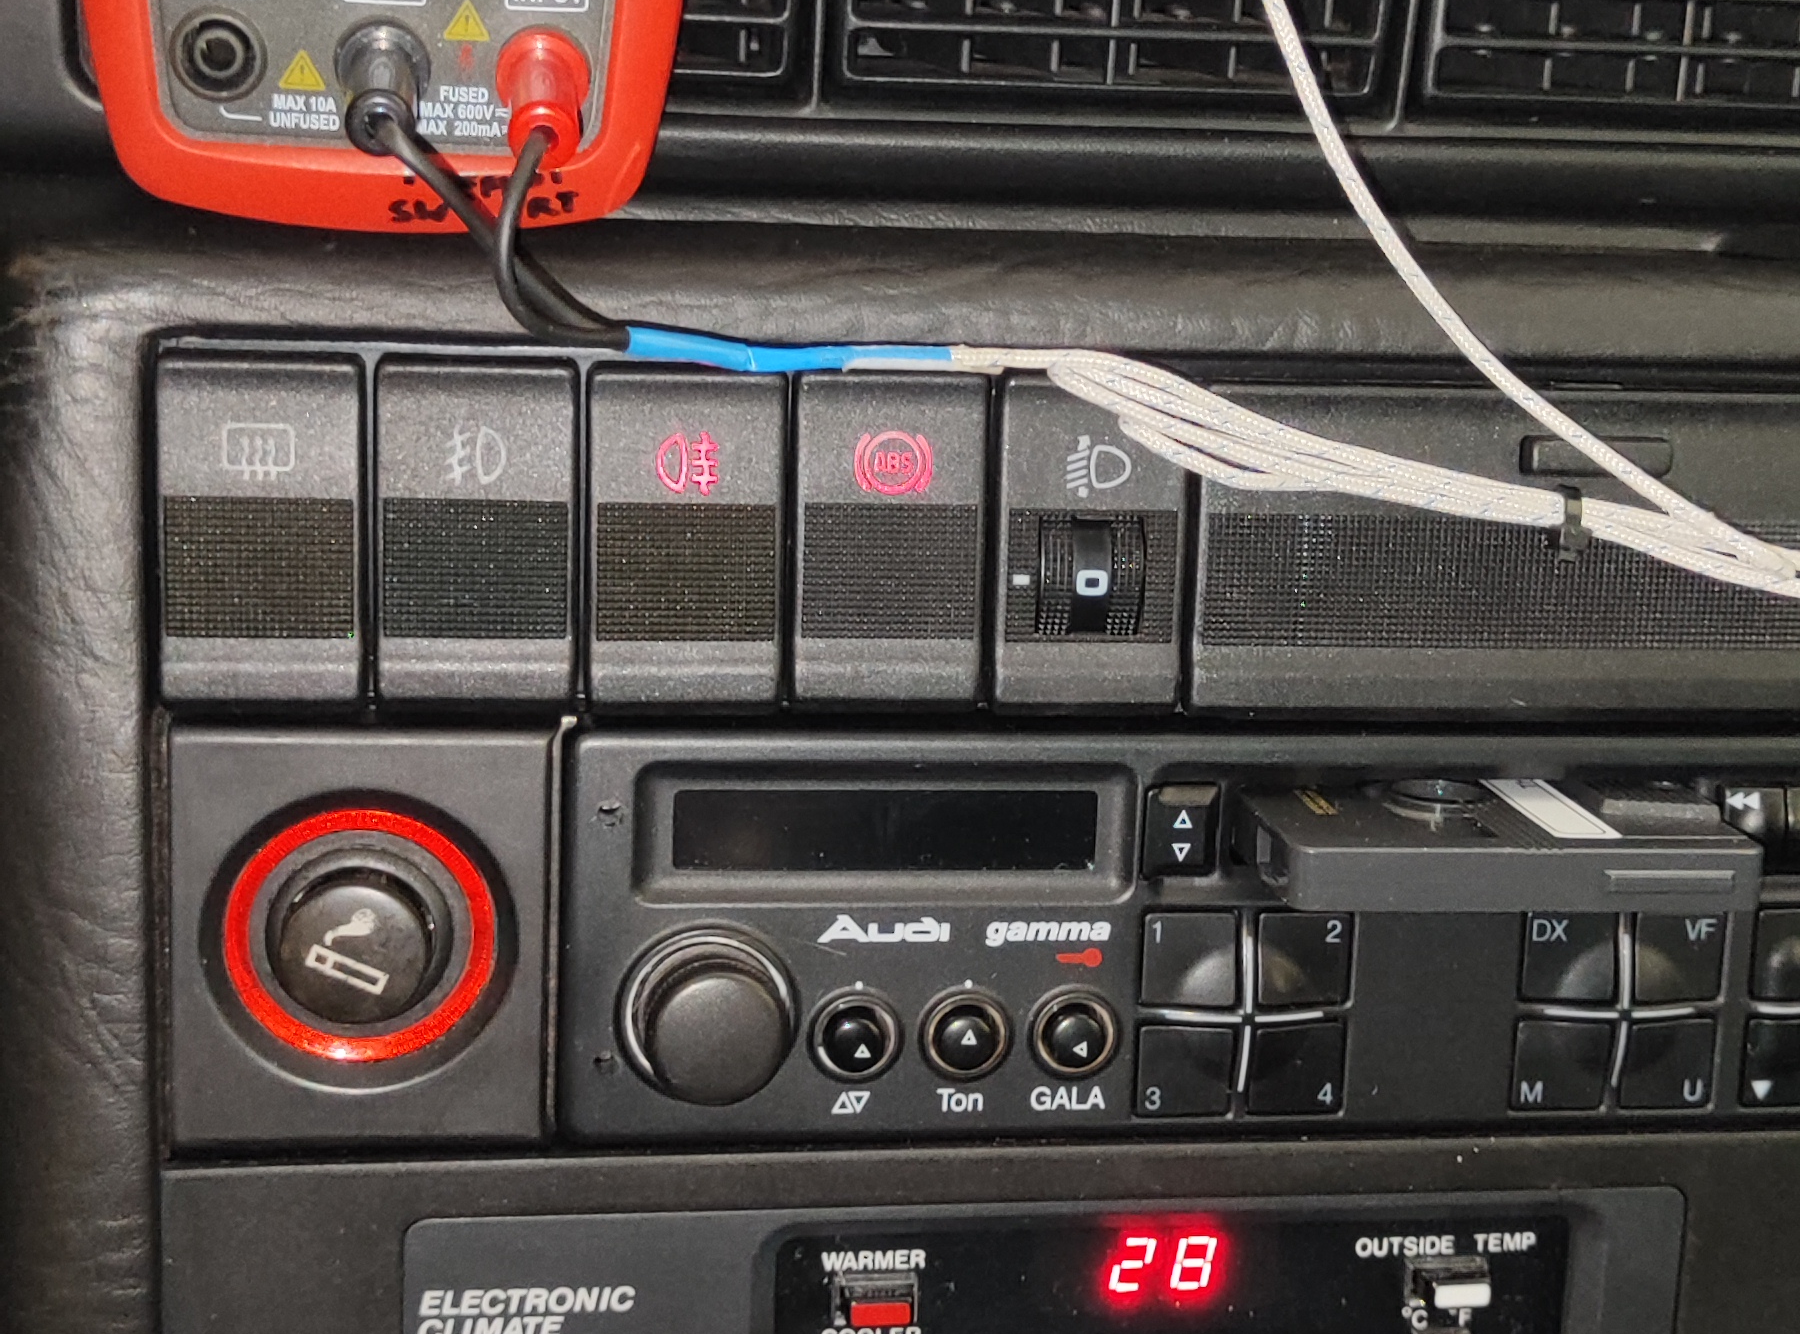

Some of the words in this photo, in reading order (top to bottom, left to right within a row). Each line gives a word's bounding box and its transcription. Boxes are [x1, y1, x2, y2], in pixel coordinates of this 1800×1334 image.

[272, 93, 306, 111] MAX
[309, 96, 336, 113] 10A
[439, 85, 489, 103] FUSED
[269, 111, 340, 132] UNFUSED
[420, 100, 454, 119] MAX
[457, 104, 495, 120] 600V
[454, 121, 502, 138] 200mA
[874, 450, 915, 475] ABS
[816, 913, 951, 944] Audi
[985, 919, 1112, 947] gamma
[1150, 920, 1164, 943] 1
[1325, 920, 1342, 943] 2
[1531, 919, 1568, 943] DX
[1684, 918, 1719, 941] VF
[937, 1087, 984, 1112] Ton
[1029, 1085, 1106, 1111] GALA
[1144, 1086, 1161, 1110] 3
[1316, 1081, 1334, 1105] 4
[1519, 1081, 1543, 1103] M
[1682, 1078, 1703, 1102] U
[1354, 1233, 1456, 1258] OUTSIDE
[1473, 1231, 1538, 1253] TEMP
[820, 1248, 927, 1271] WARMER
[1107, 1234, 1218, 1293] 28
[418, 1285, 637, 1317] ELECTRONIC
